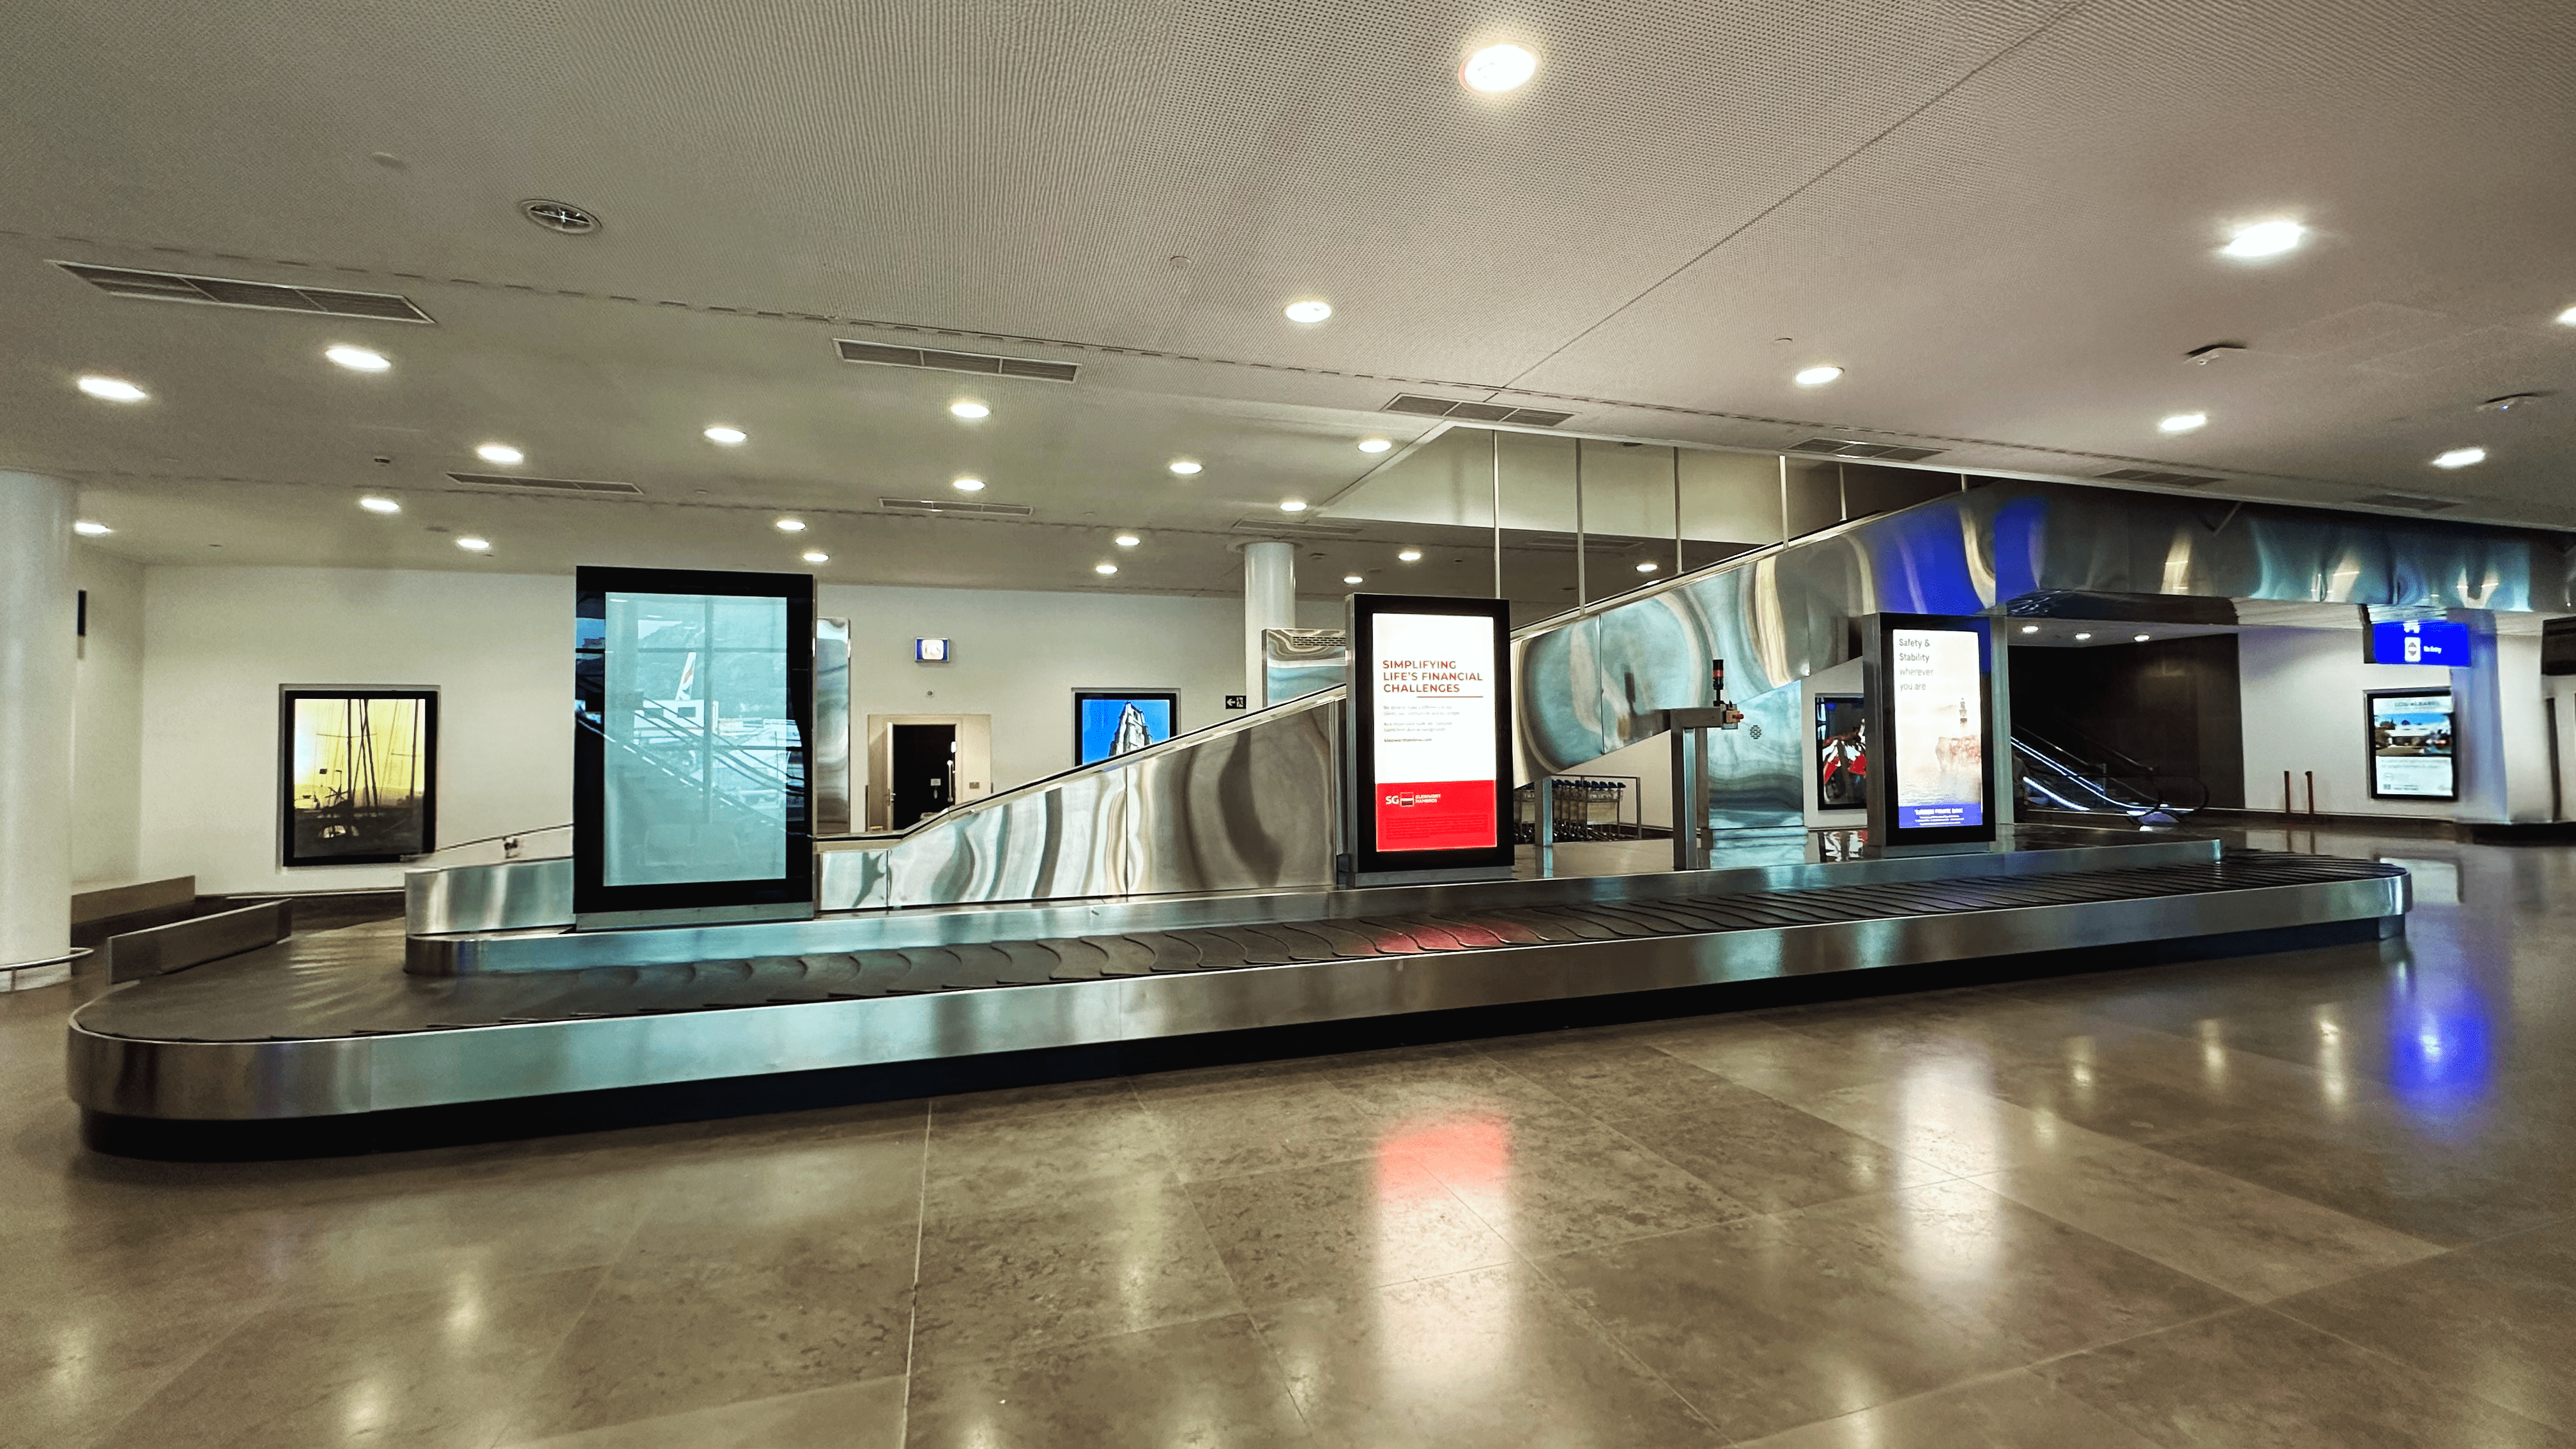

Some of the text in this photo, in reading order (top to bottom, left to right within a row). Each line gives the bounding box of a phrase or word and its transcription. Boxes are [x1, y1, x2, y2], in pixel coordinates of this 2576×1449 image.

[1899, 638, 1930, 649] Safety &
[1899, 653, 1929, 663] Stability
[1383, 660, 1457, 669] SIMPLIFYING
[1899, 667, 1933, 676] wherever
[1383, 672, 1483, 681] LIFE'S FINANCIAL
[1384, 684, 1460, 693] CHALLENGES
[1900, 684, 1912, 692] you
[1386, 795, 1399, 804] SG
